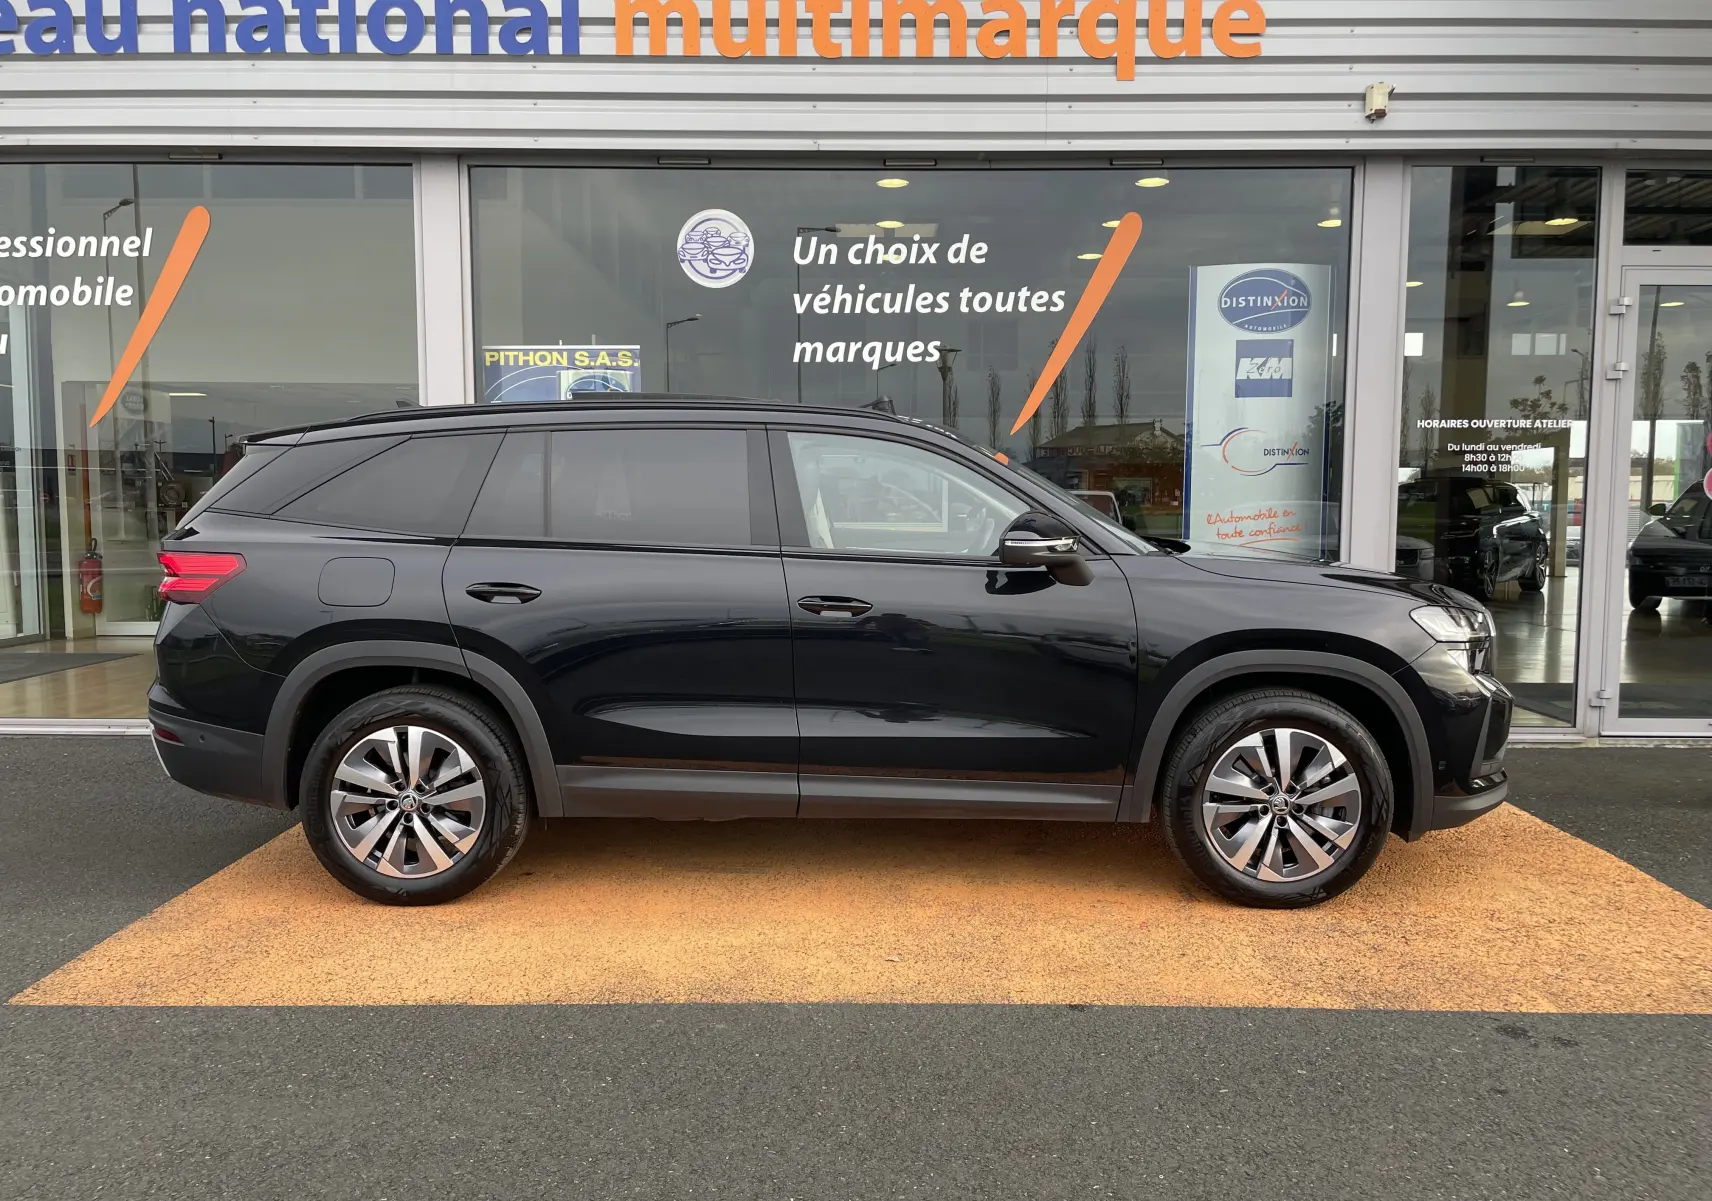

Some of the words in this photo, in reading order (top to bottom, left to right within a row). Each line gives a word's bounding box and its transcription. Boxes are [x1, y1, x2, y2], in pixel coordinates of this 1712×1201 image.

[173, 0, 580, 55] national
[615, 0, 1267, 81] multimarque
[0, 227, 153, 258] essionnel
[793, 236, 838, 265] Un
[847, 234, 940, 265] choix
[947, 234, 989, 265] de
[0, 276, 134, 307] omobile
[793, 284, 950, 314] véhicules
[959, 286, 1066, 313] toutes
[1221, 291, 1308, 310] DISTINXION
[1244, 323, 1288, 332] AUTOMOBILE
[485, 350, 568, 367] PITHON
[574, 350, 639, 367] S.A.S.
[793, 339, 941, 370] marques
[1417, 419, 1469, 429] HORAIRES
[1471, 419, 1532, 429] OUVERTURE
[1534, 419, 1573, 429] ATELIER
[1264, 445, 1309, 458] DISTINXION
[1447, 443, 1460, 451] Du
[1461, 443, 1485, 451] lundi
[1500, 442, 1542, 451] vendredi
[1464, 453, 1487, 462] 8h30
[1489, 453, 1496, 462] à
[1462, 464, 1488, 473] 14h00
[1490, 464, 1497, 473] à
[1499, 464, 1525, 473] 18h00
[1283, 509, 1296, 518] en
[1216, 524, 1244, 540] toute
[1249, 522, 1301, 538] confiance
